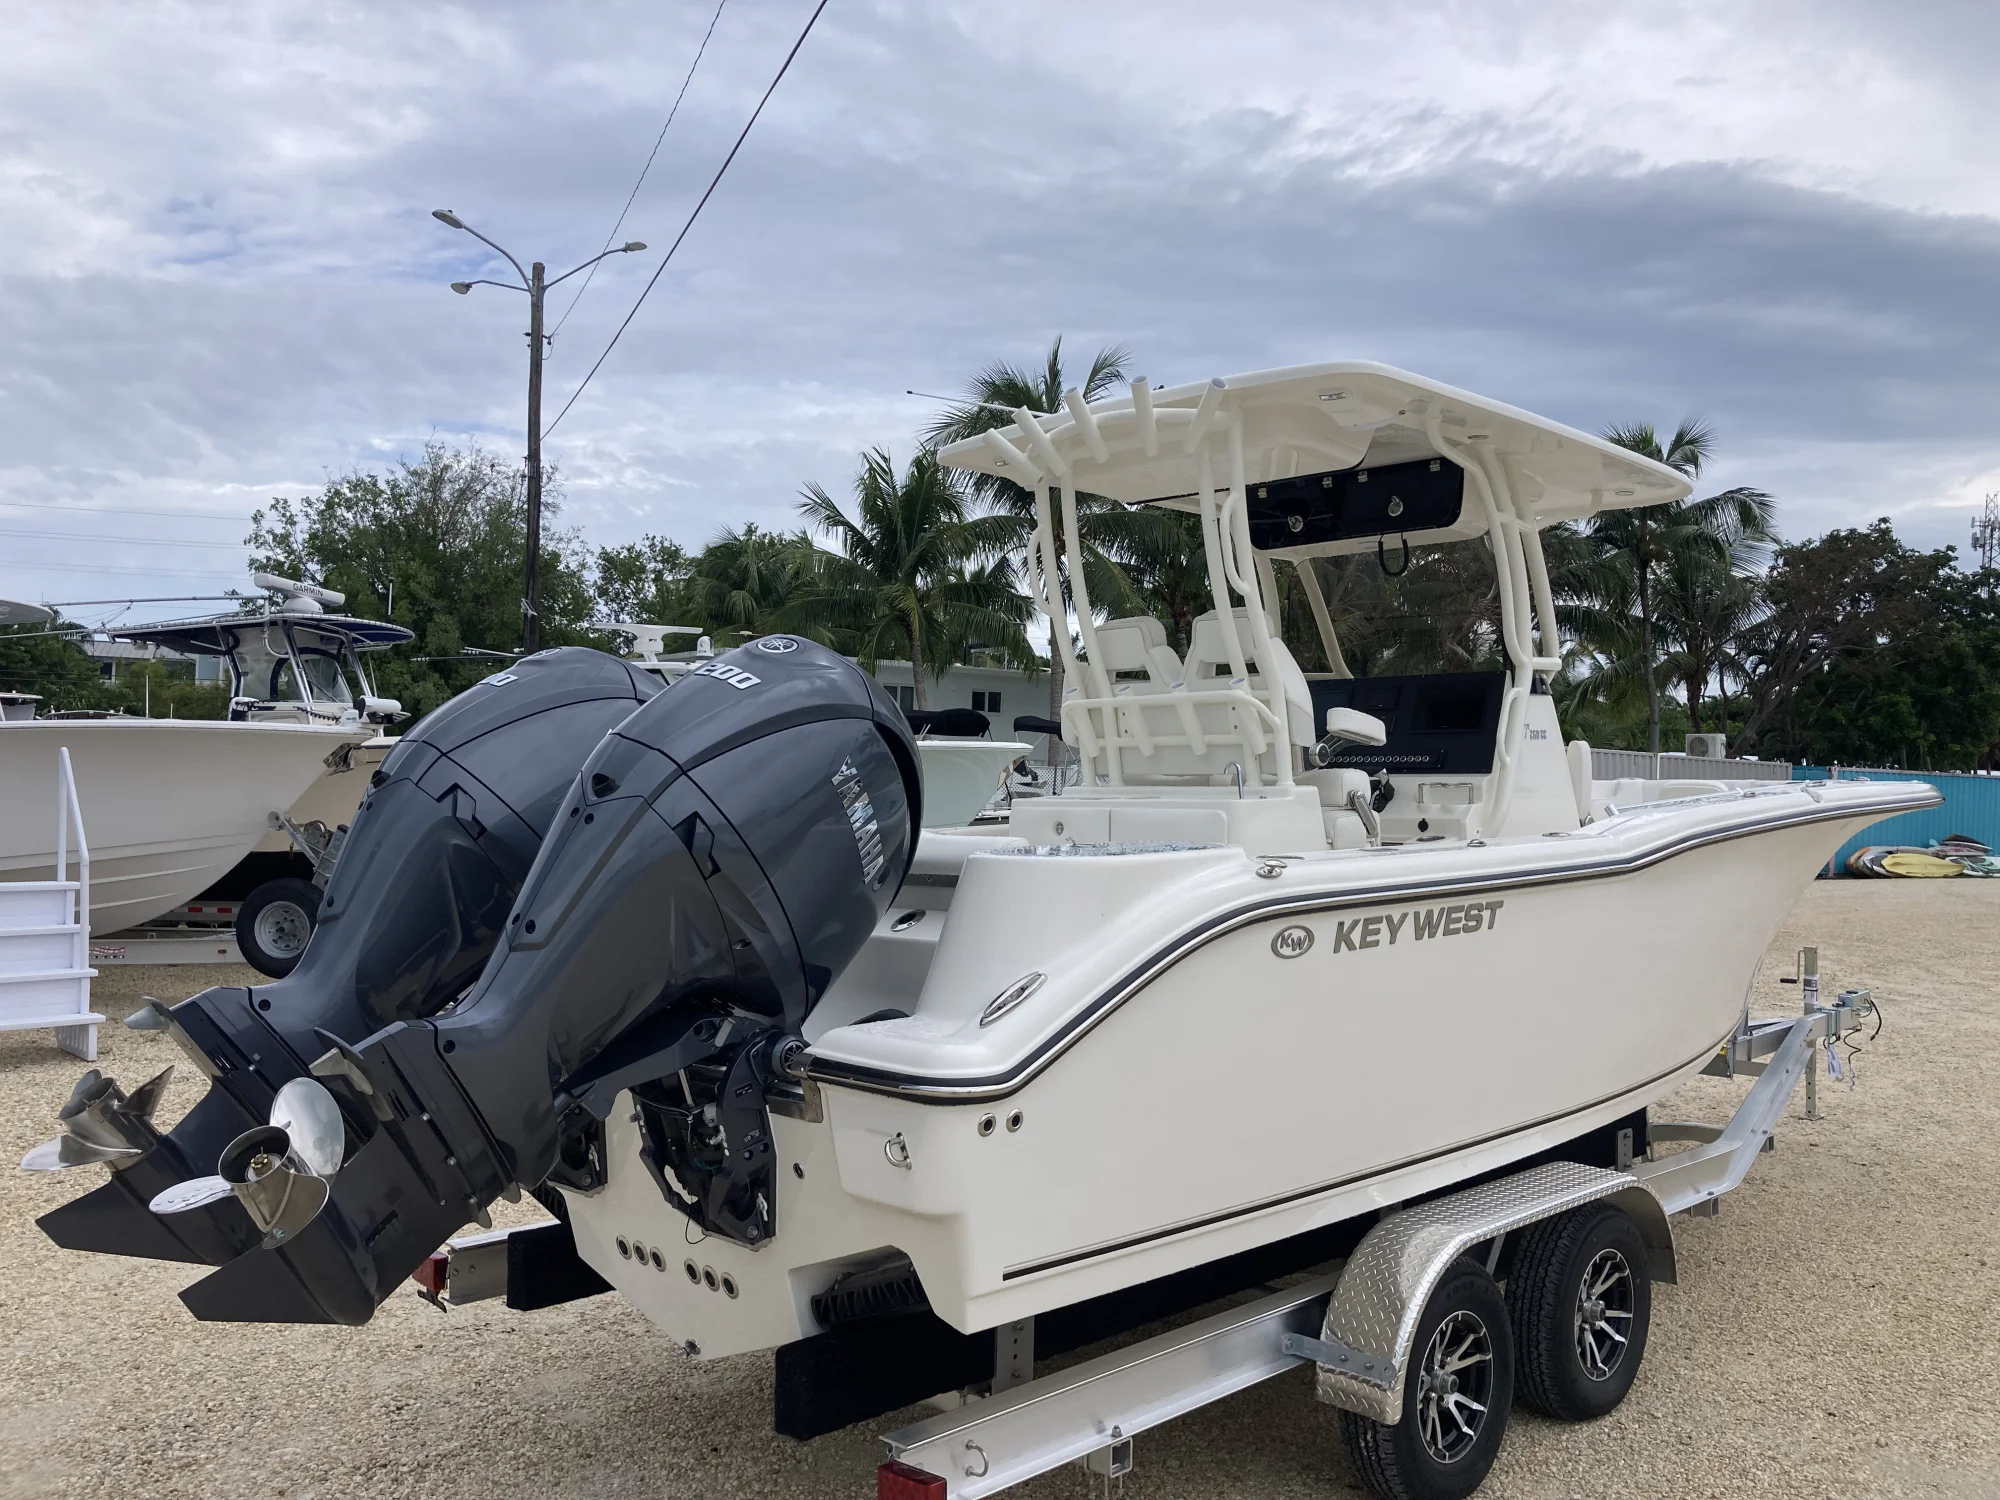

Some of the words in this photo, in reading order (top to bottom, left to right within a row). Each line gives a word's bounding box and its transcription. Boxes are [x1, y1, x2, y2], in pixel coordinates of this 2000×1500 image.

[293, 583, 324, 597] GARMIN
[694, 663, 762, 690] 200
[831, 755, 884, 885] YAMAHA
[1333, 911, 1409, 954] KEY
[1413, 900, 1505, 941] WEST
